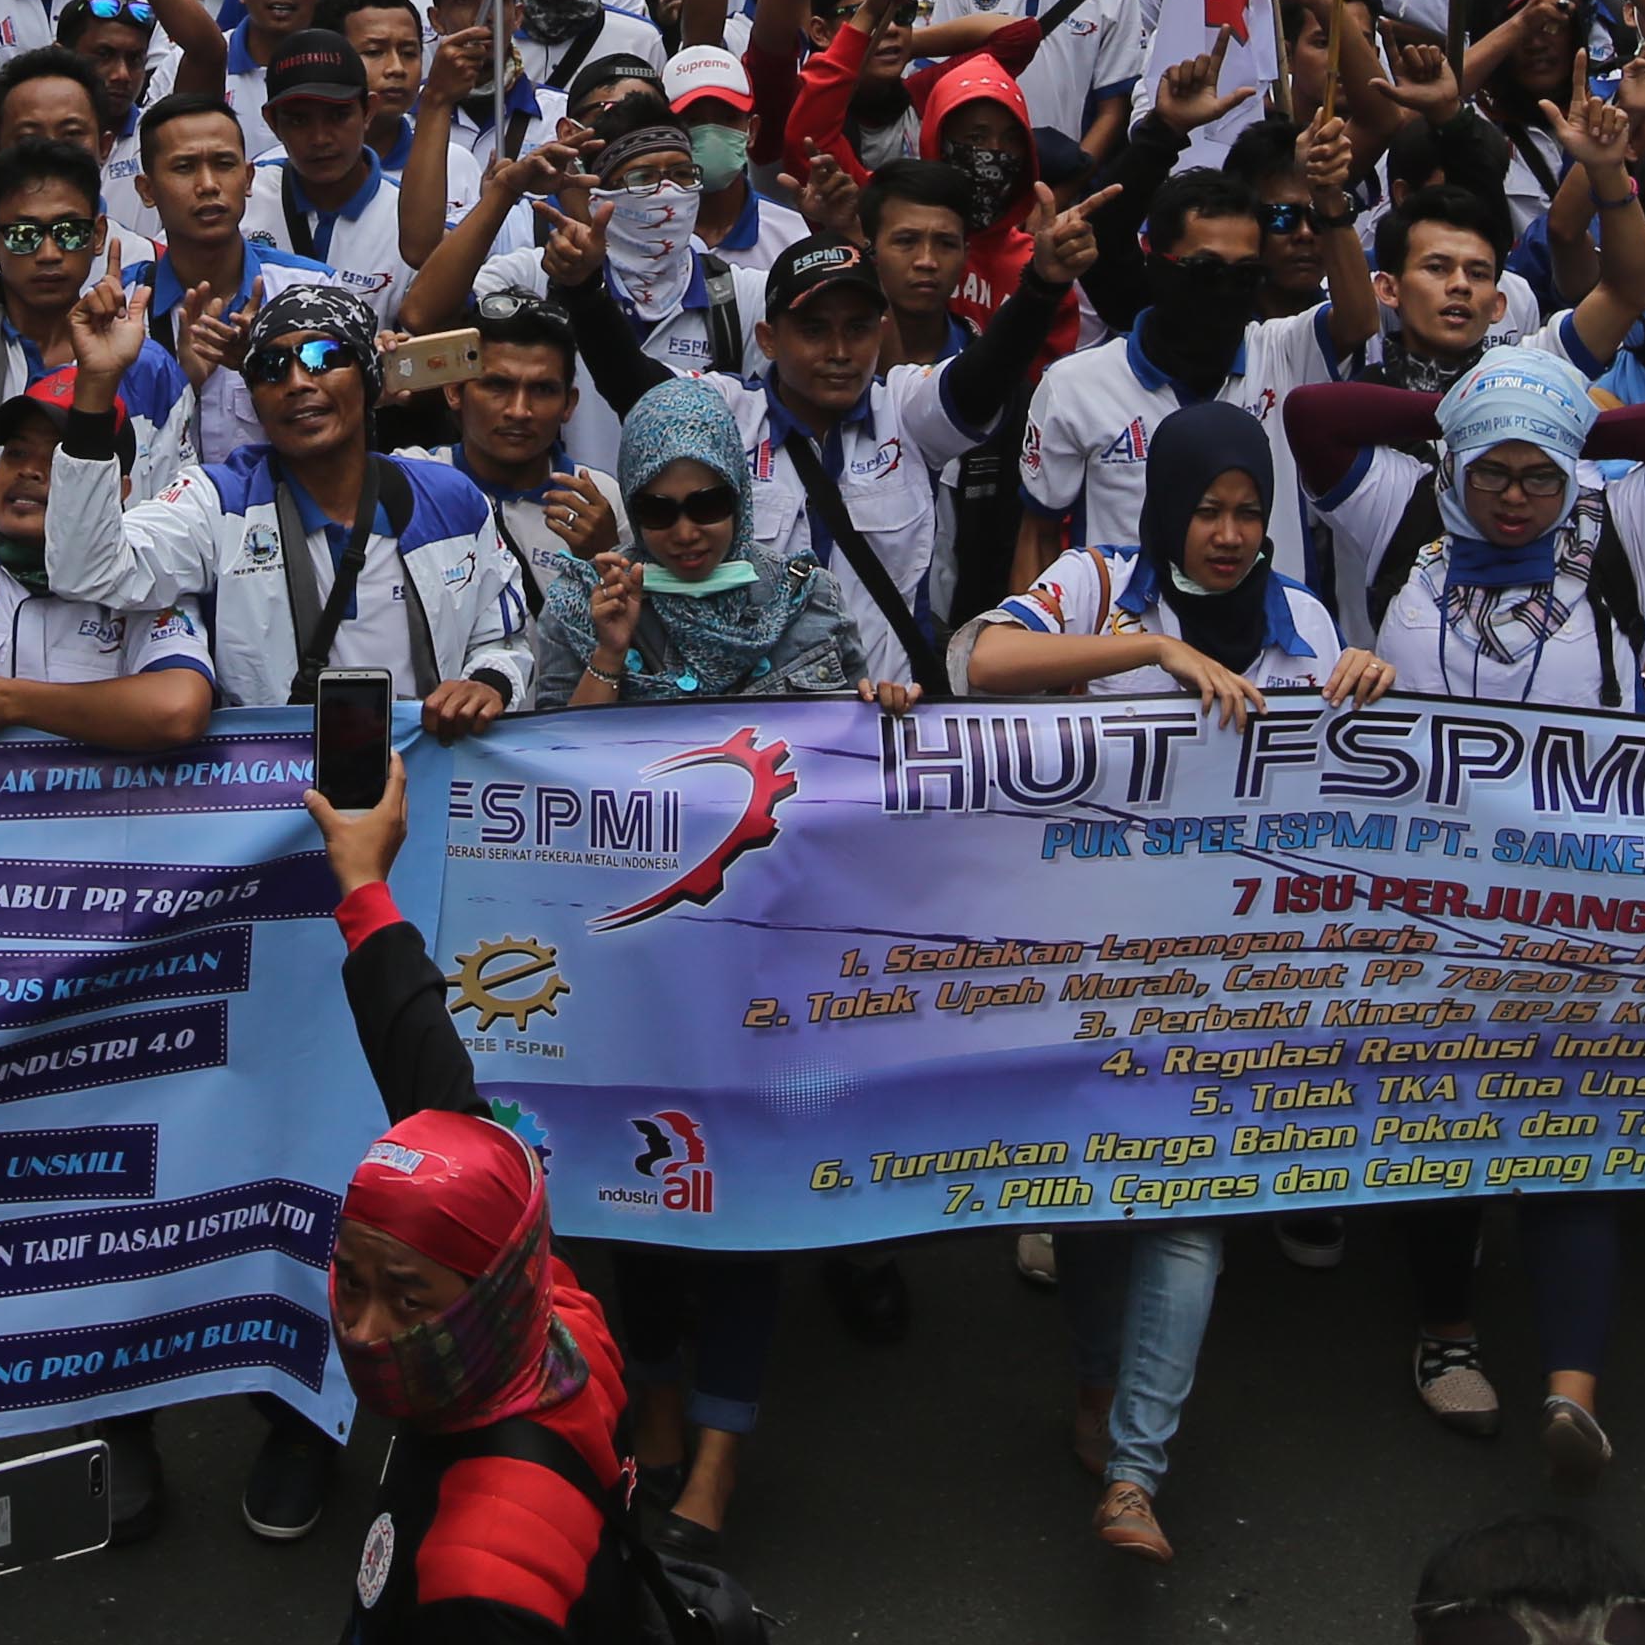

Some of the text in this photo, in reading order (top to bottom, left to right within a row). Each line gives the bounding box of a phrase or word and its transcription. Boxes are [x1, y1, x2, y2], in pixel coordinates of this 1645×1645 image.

[674, 56, 732, 76] Supreme
[341, 269, 376, 289] FSPMI
[793, 245, 846, 270] FSPMI
[1494, 414, 1511, 431] PUK
[45, 765, 104, 792] PHK
[112, 763, 167, 789] DAN
[173, 758, 315, 788] PEMAGANG
[876, 710, 1200, 815] HUT
[449, 780, 679, 853] FSPMI
[1041, 819, 1132, 860] PUK
[1142, 813, 1248, 857] SPEE
[1255, 810, 1400, 853] FSPMI
[1406, 816, 1479, 859] PT.
[487, 847, 680, 871] SERIKAT PEKERJA METAL INDONESIA
[132, 878, 262, 918] 78/2015
[1232, 877, 1260, 917] 7
[1272, 874, 1363, 917] ISU
[840, 949, 873, 979] 1.
[883, 937, 1081, 976] Sediakan
[1097, 926, 1304, 965] Lapangan
[1316, 918, 1437, 957] Kerja
[1497, 932, 1613, 967] Tolak
[51, 950, 224, 1001] KESEHATAN
[742, 997, 789, 1028] 2.
[805, 985, 919, 1025] Tolak
[935, 977, 1046, 1013] Upah
[1059, 964, 1211, 1003] Murah,
[1222, 961, 1348, 996] Cabut
[1361, 960, 1425, 989] PP
[1440, 963, 1620, 997] 78/2015
[1072, 1011, 1119, 1041] 3.
[1128, 1002, 1314, 1039] Perbaiki
[1322, 996, 1475, 1031] Kinerja
[1487, 999, 1600, 1025] BPJS
[147, 1026, 197, 1057] 4.0
[504, 1039, 565, 1059] FSPMI
[1100, 1047, 1148, 1078] 4.
[1161, 1038, 1345, 1076] Regulasi
[1355, 1033, 1539, 1068] Revolusi
[1190, 1086, 1234, 1117] 5.
[1247, 1080, 1356, 1115] Tolak
[1375, 1075, 1457, 1105] TKA
[1475, 1071, 1570, 1101] Cina
[4, 1149, 129, 1180] UNSKILL
[808, 1159, 854, 1192] 6.
[869, 1136, 1069, 1186] Turunkan
[1083, 1131, 1215, 1168] Harga
[1230, 1121, 1358, 1160] Bahan
[1370, 1112, 1501, 1147] Pokok
[1518, 1109, 1599, 1139] dan
[598, 1169, 713, 1214] industri all
[944, 1185, 984, 1216] 7.
[997, 1174, 1094, 1209] Pilih
[1109, 1171, 1260, 1212] Capres
[1271, 1163, 1351, 1195] dan
[1361, 1156, 1476, 1191] Caleg
[1487, 1150, 1592, 1187] yang
[21, 1232, 93, 1270] TARIF
[97, 1221, 181, 1259] DASAR
[40, 1348, 107, 1383] PRO
[112, 1330, 197, 1371] KAUM
[201, 1319, 301, 1353] BURUH
